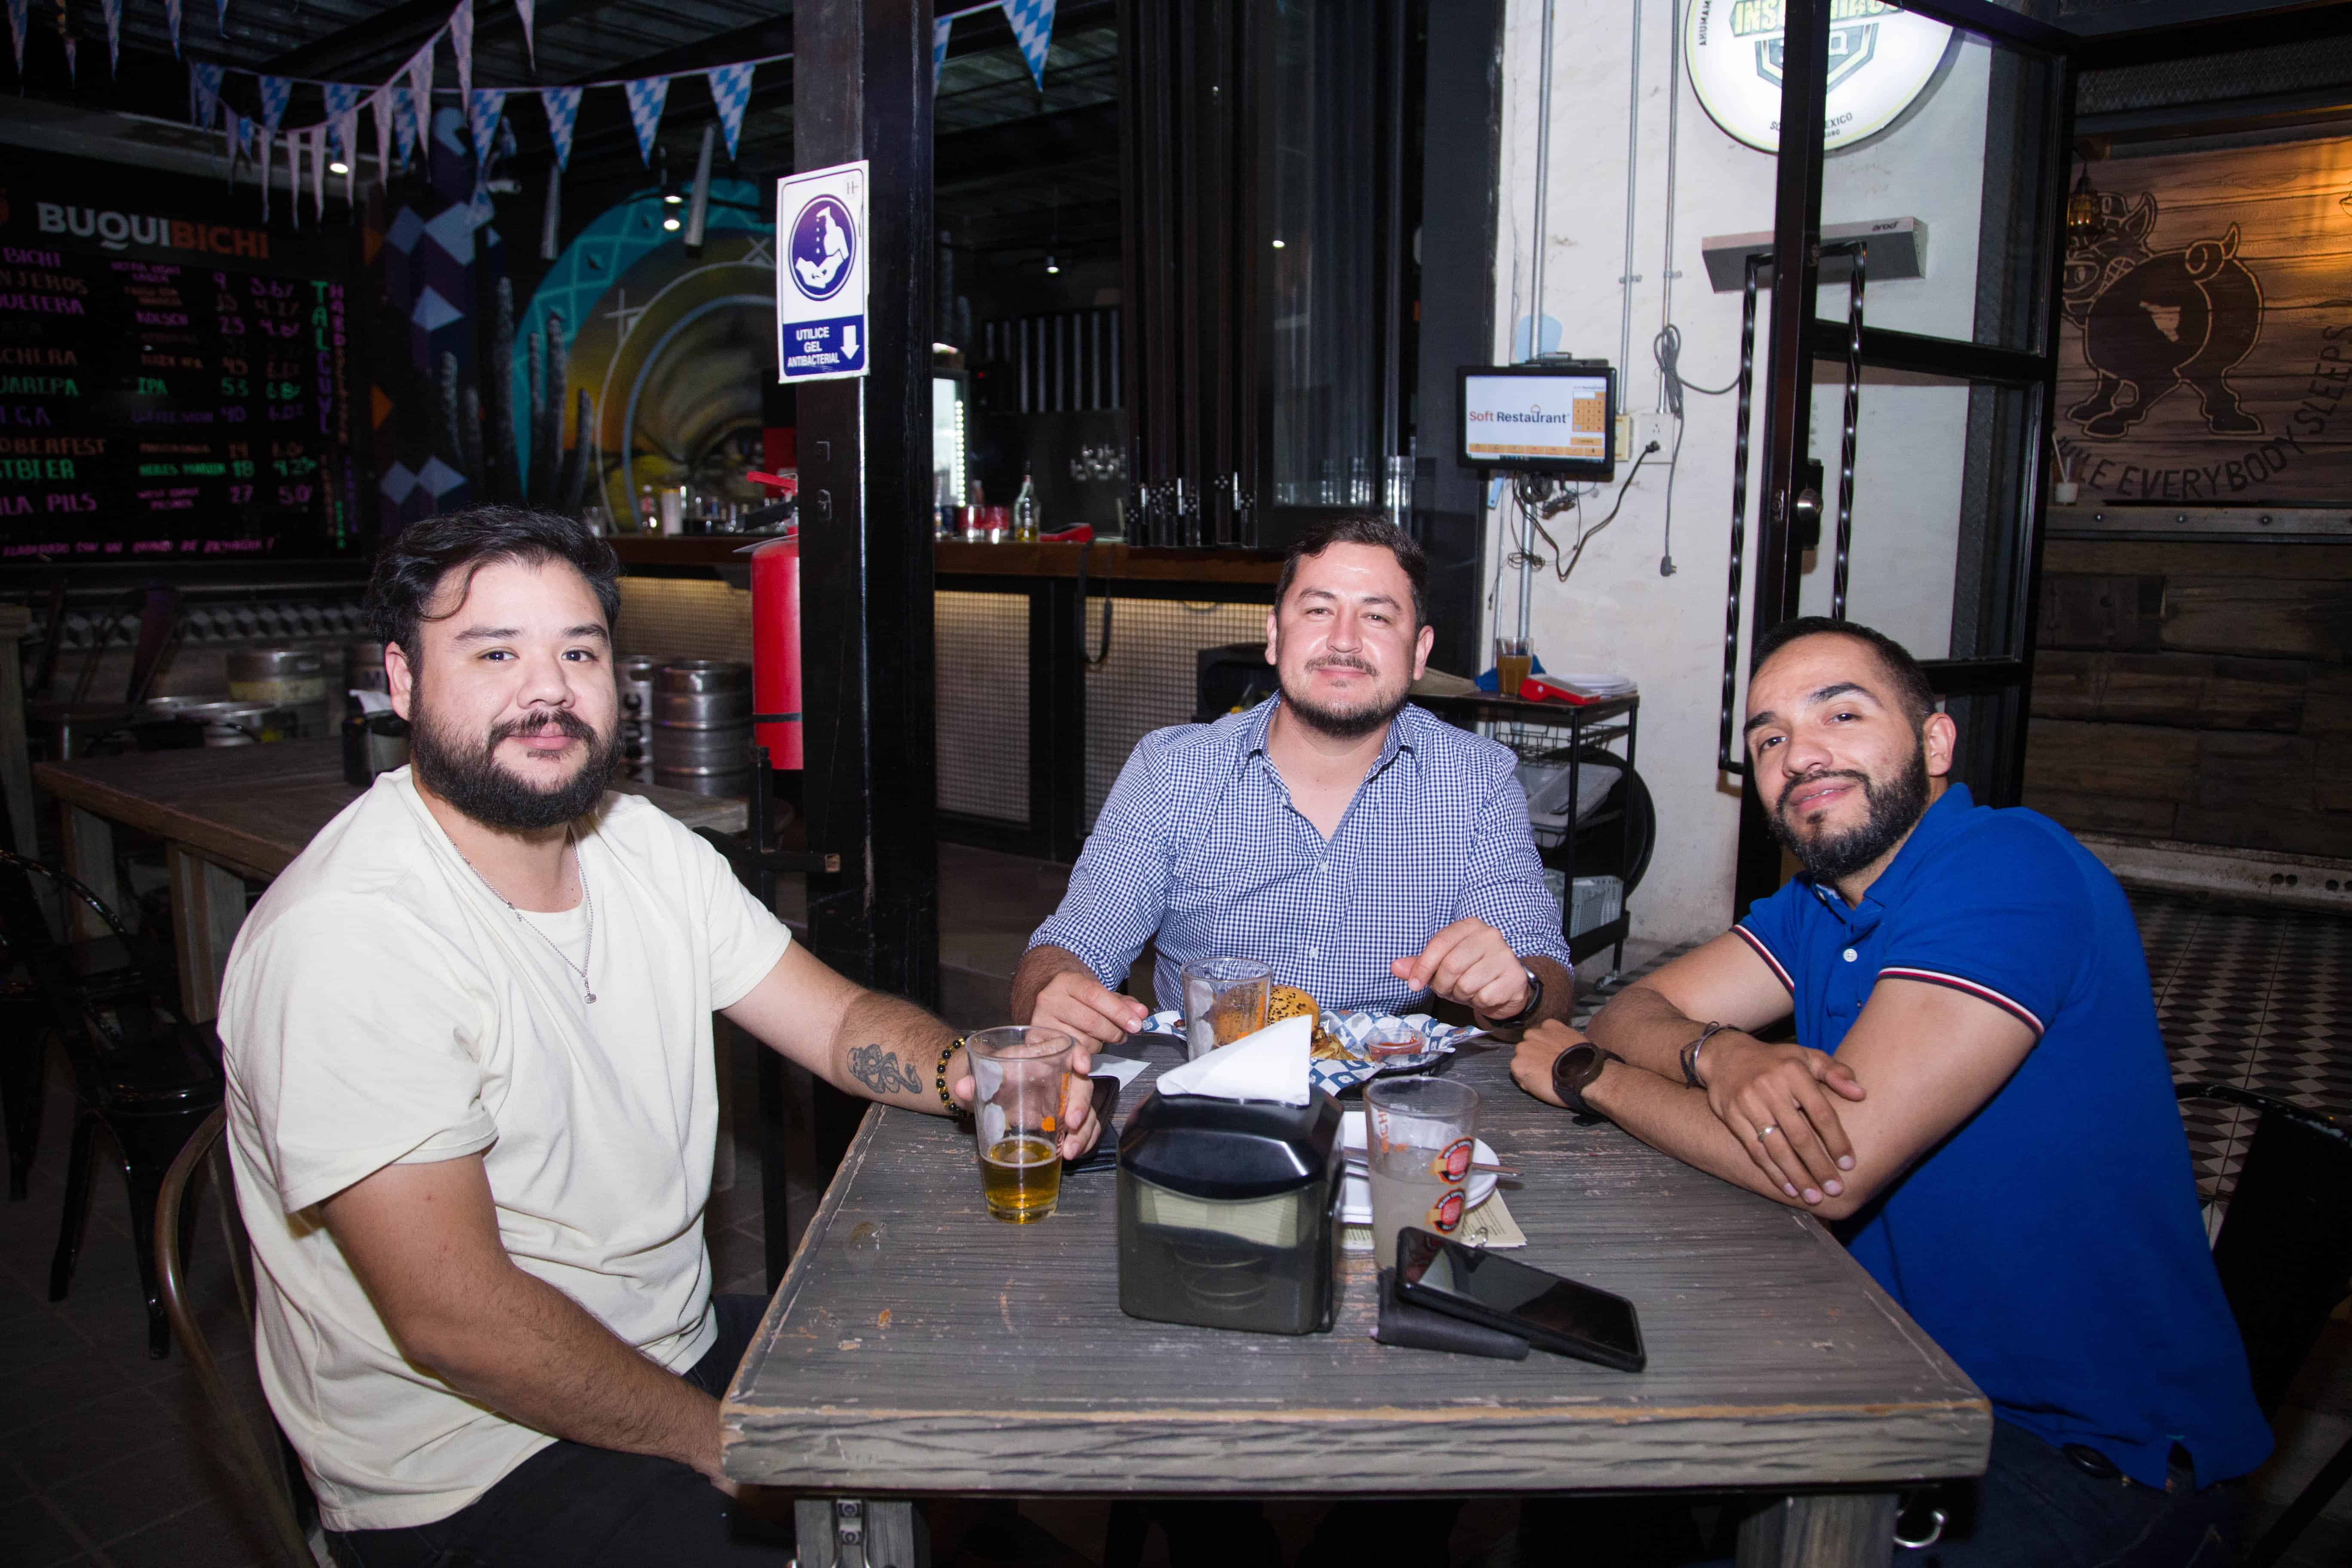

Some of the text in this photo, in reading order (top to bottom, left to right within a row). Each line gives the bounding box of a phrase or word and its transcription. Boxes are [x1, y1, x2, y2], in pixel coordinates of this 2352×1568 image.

[1825, 112, 1853, 129] EXICO
[796, 327, 830, 340] UTILICE
[804, 341, 822, 353] GEL
[787, 352, 840, 368] ANTIBACTERIAL
[1469, 411, 1566, 423] Soft Restaurant
[2117, 425, 2304, 499] EVERYBODY
